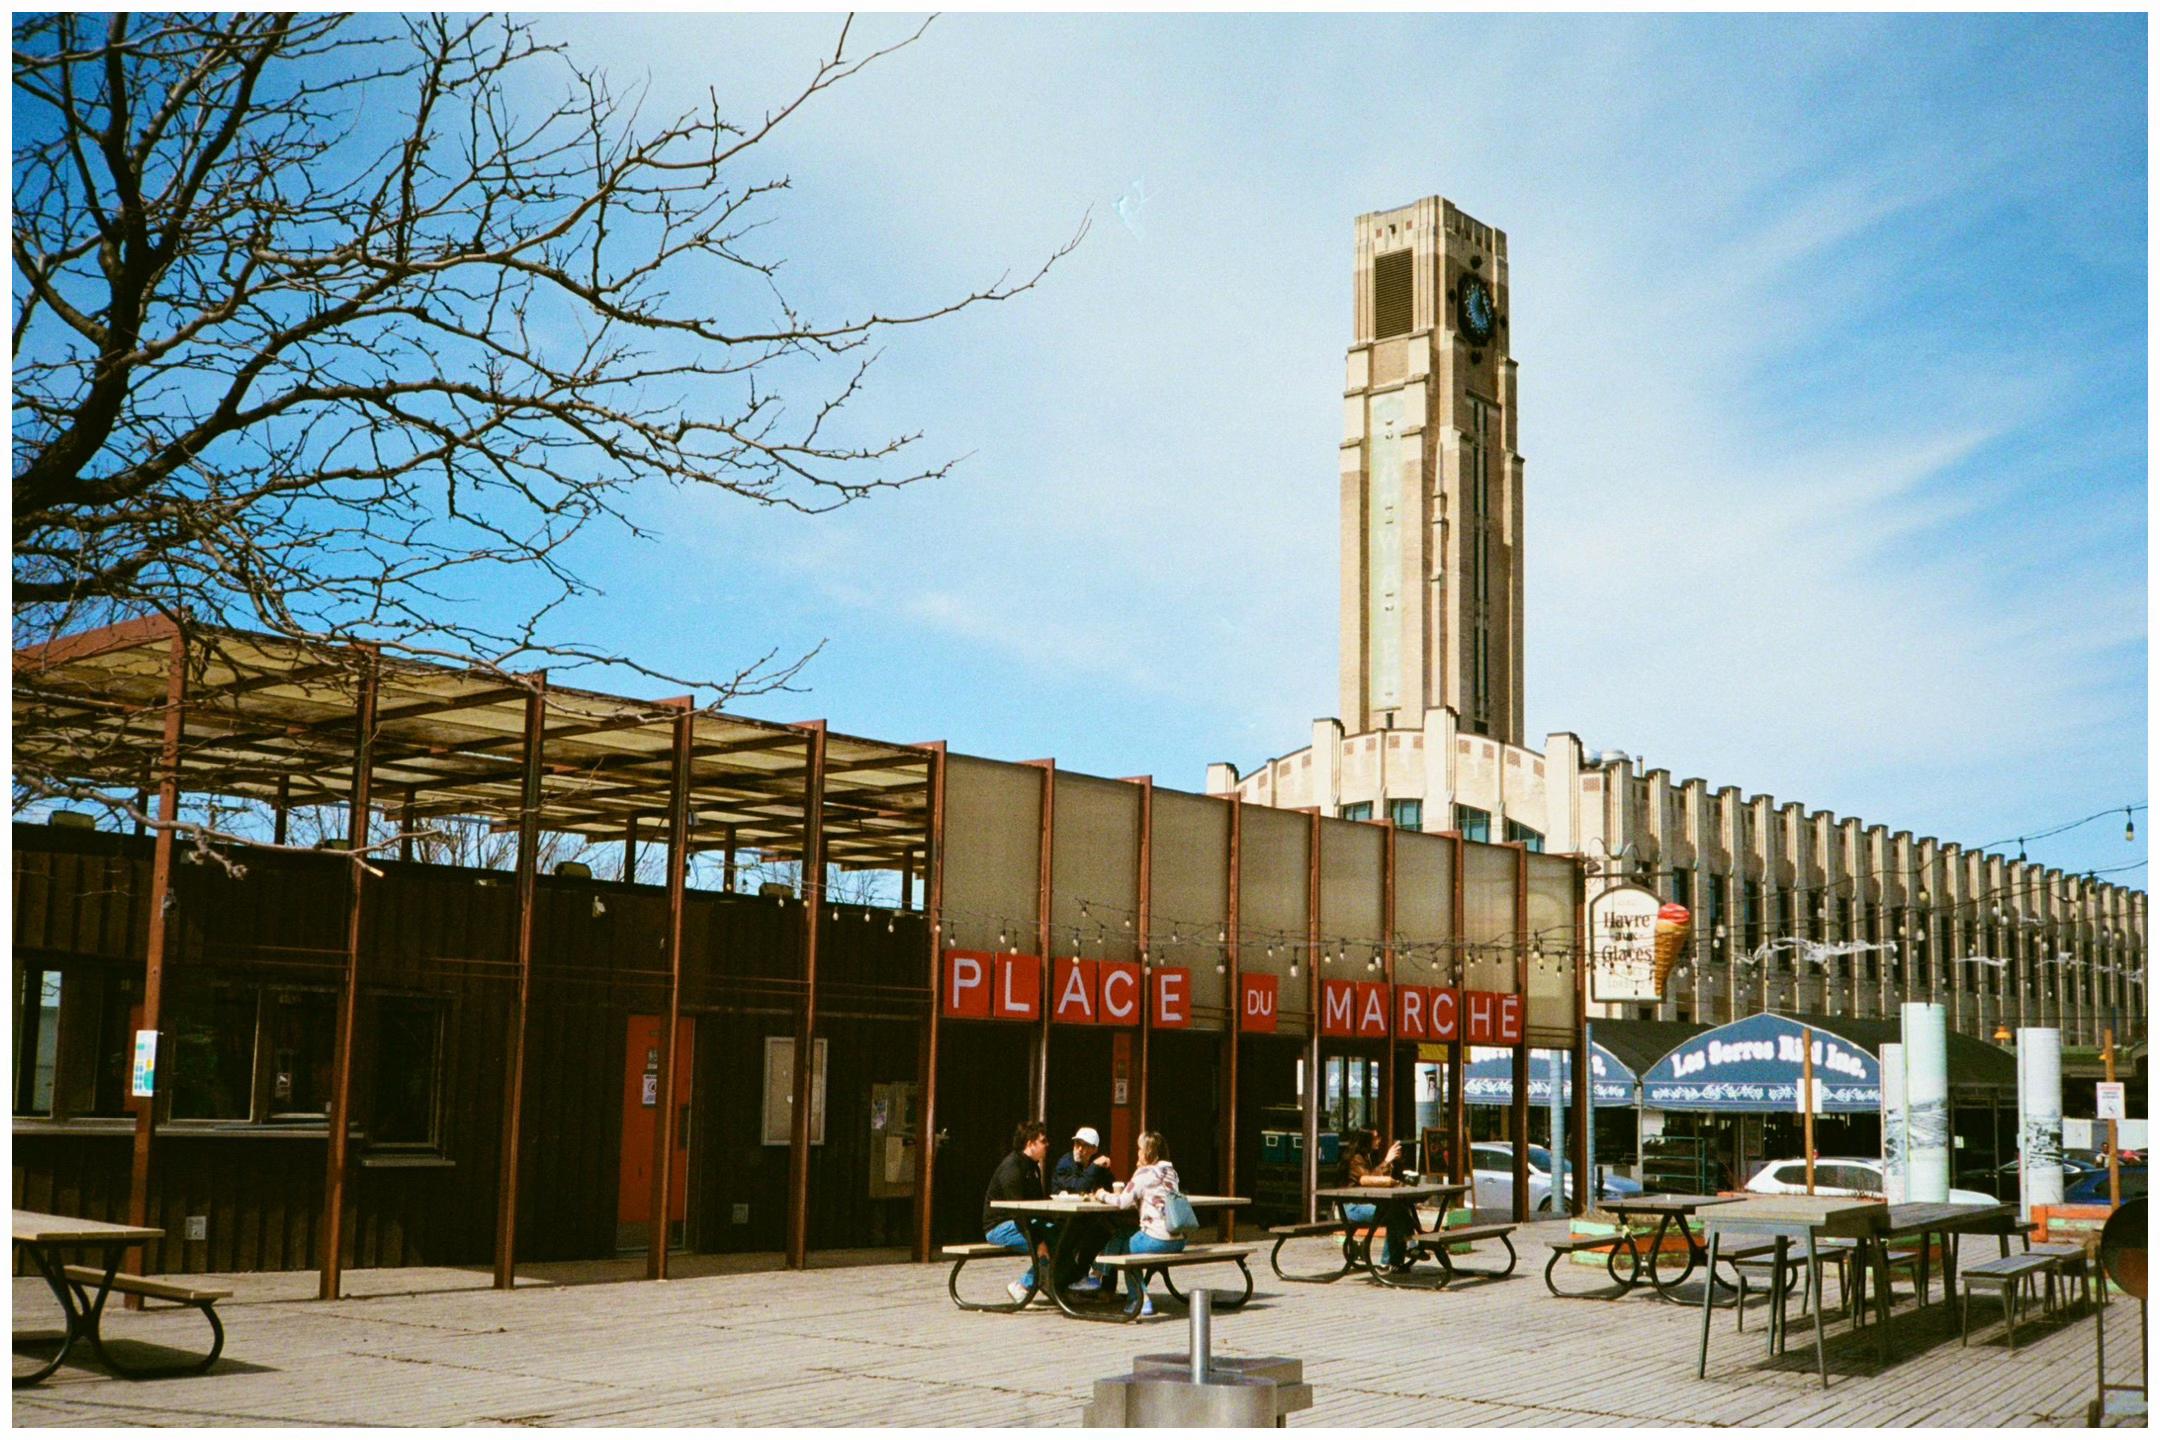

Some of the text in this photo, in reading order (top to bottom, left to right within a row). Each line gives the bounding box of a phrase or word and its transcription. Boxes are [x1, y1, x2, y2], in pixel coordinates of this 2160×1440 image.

[1603, 911, 1650, 929] Havre
[953, 958, 1519, 1038] PLACE DU MARCHÉ
[1671, 1050, 1706, 1078] Les
[1709, 1039, 1774, 1065] Serres
[1825, 1043, 1866, 1079] Inc.
